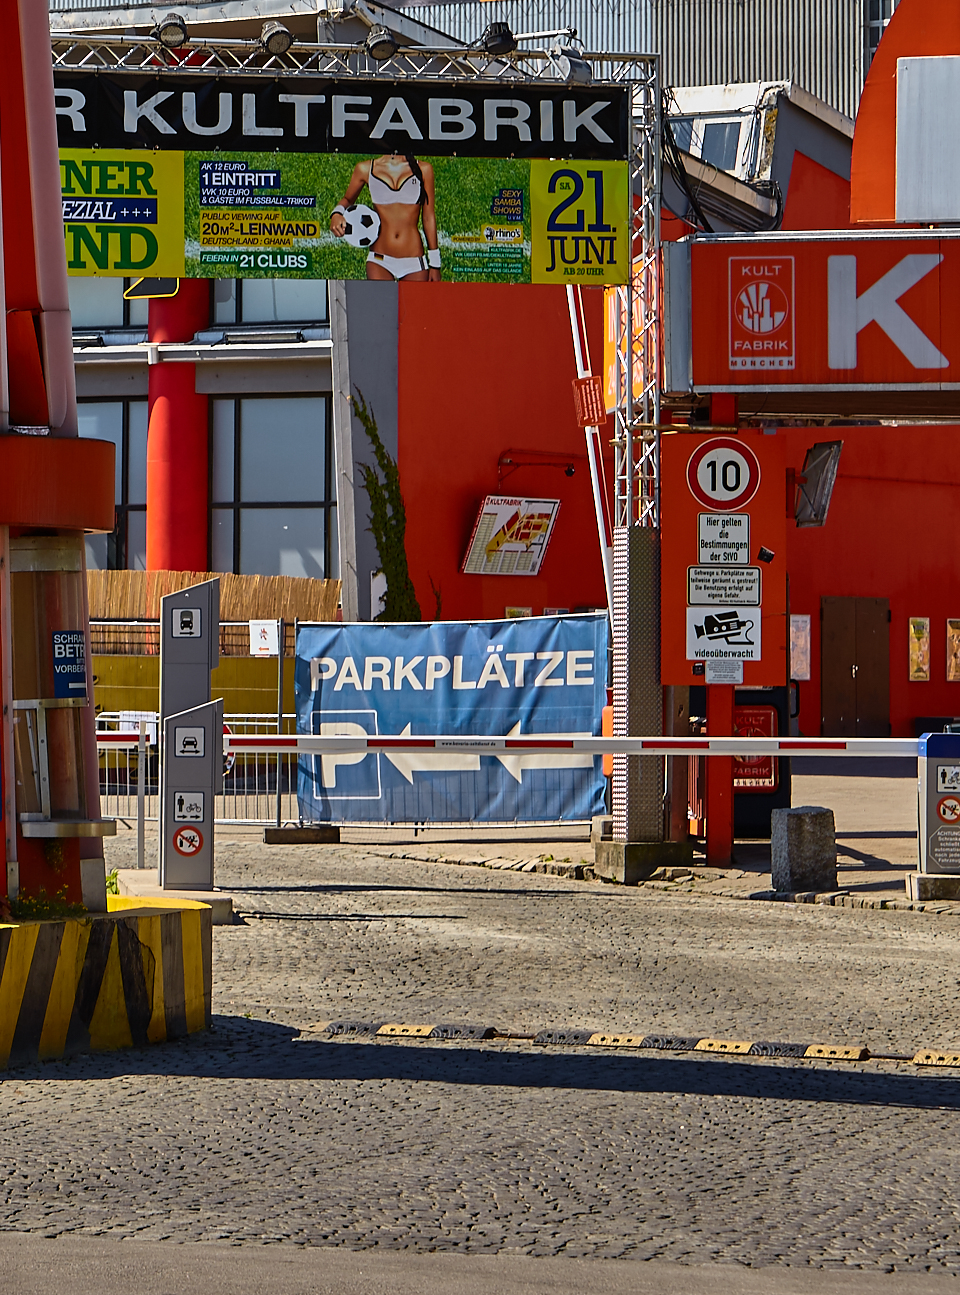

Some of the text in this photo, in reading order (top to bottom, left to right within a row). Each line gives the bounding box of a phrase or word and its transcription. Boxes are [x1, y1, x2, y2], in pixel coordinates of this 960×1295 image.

[123, 90, 614, 143] KULTFABRIK
[201, 163, 246, 171] AK 12 EURO
[202, 172, 277, 186] 1 EINTRITT
[559, 182, 571, 190] SA
[219, 188, 227, 196] 10
[228, 188, 250, 196] EURO
[502, 190, 522, 198] SEXY
[202, 196, 207, 204] &
[208, 196, 234, 204] GÄSTE
[245, 197, 315, 205] FUSSBALL-TRIKOT
[494, 198, 521, 206] SAMBA
[546, 168, 617, 233] 21.
[202, 213, 280, 221] PUBLIC VIEWING AUF
[495, 228, 522, 238] rhino's
[202, 237, 259, 245] DEUTSCHLAND
[64, 224, 159, 270] ND
[545, 236, 617, 272] JUNI
[202, 254, 308, 268] FEIERN IN 21 CLUBS
[563, 267, 576, 275] AB
[587, 268, 604, 276] UHR
[742, 265, 782, 276] KULT
[827, 253, 950, 369] K
[734, 340, 788, 350] FABRIK
[730, 359, 793, 367] MÜNCHEN
[706, 460, 741, 492] 10
[489, 498, 523, 506] KULTFABRIK
[706, 517, 742, 528] Hier gelten
[719, 530, 729, 538] die
[701, 539, 747, 551] Bestimmungen
[710, 552, 738, 561] der StVO
[694, 569, 714, 577] Gehwege
[721, 569, 744, 577] Parkplätze
[694, 649, 753, 658] videoüberwacht
[310, 645, 595, 692] PARKPLÄTZE
[319, 722, 370, 789] P
